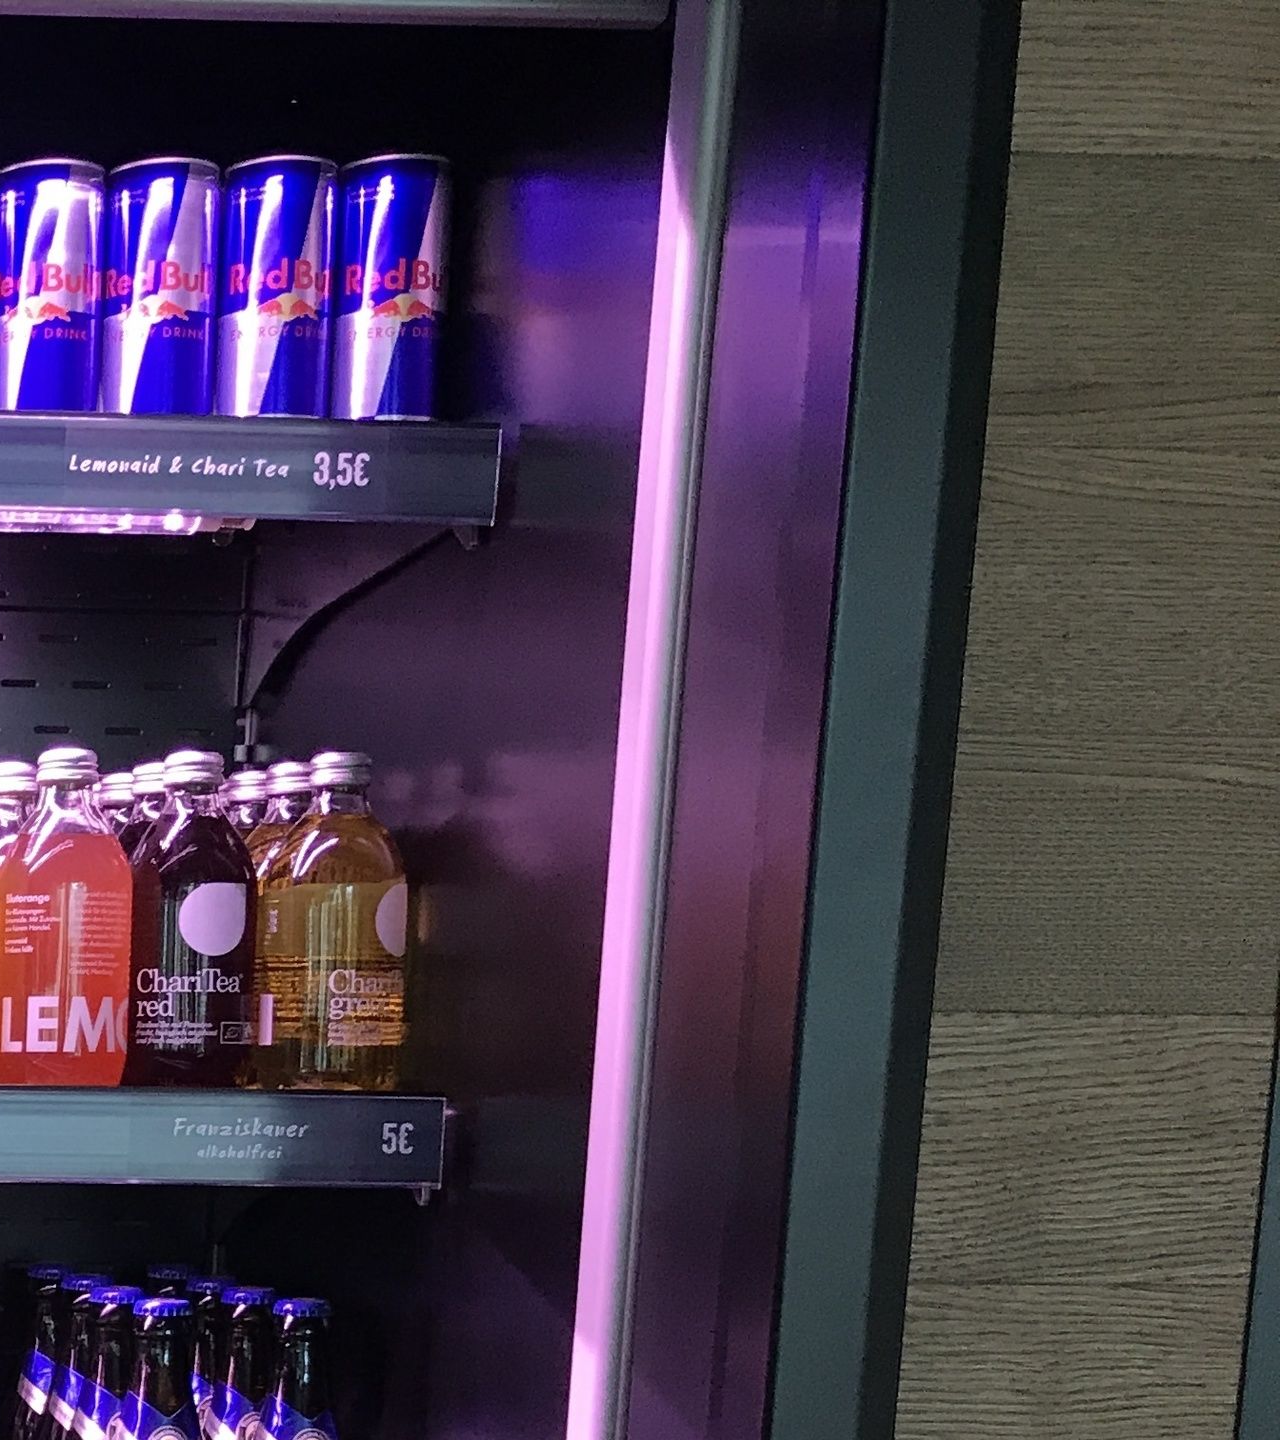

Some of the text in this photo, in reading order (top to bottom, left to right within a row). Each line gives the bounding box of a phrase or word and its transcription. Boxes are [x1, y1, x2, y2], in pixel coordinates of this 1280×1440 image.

[68, 452, 290, 479] Lemonaid & Chari Tea
[312, 452, 370, 490] 3,5€
[136, 968, 240, 993] ChariTea
[136, 992, 174, 1017] red
[172, 1117, 310, 1141] Franziskaner
[381, 1122, 415, 1156] 5€
[196, 1145, 284, 1161] alkoholfrei
